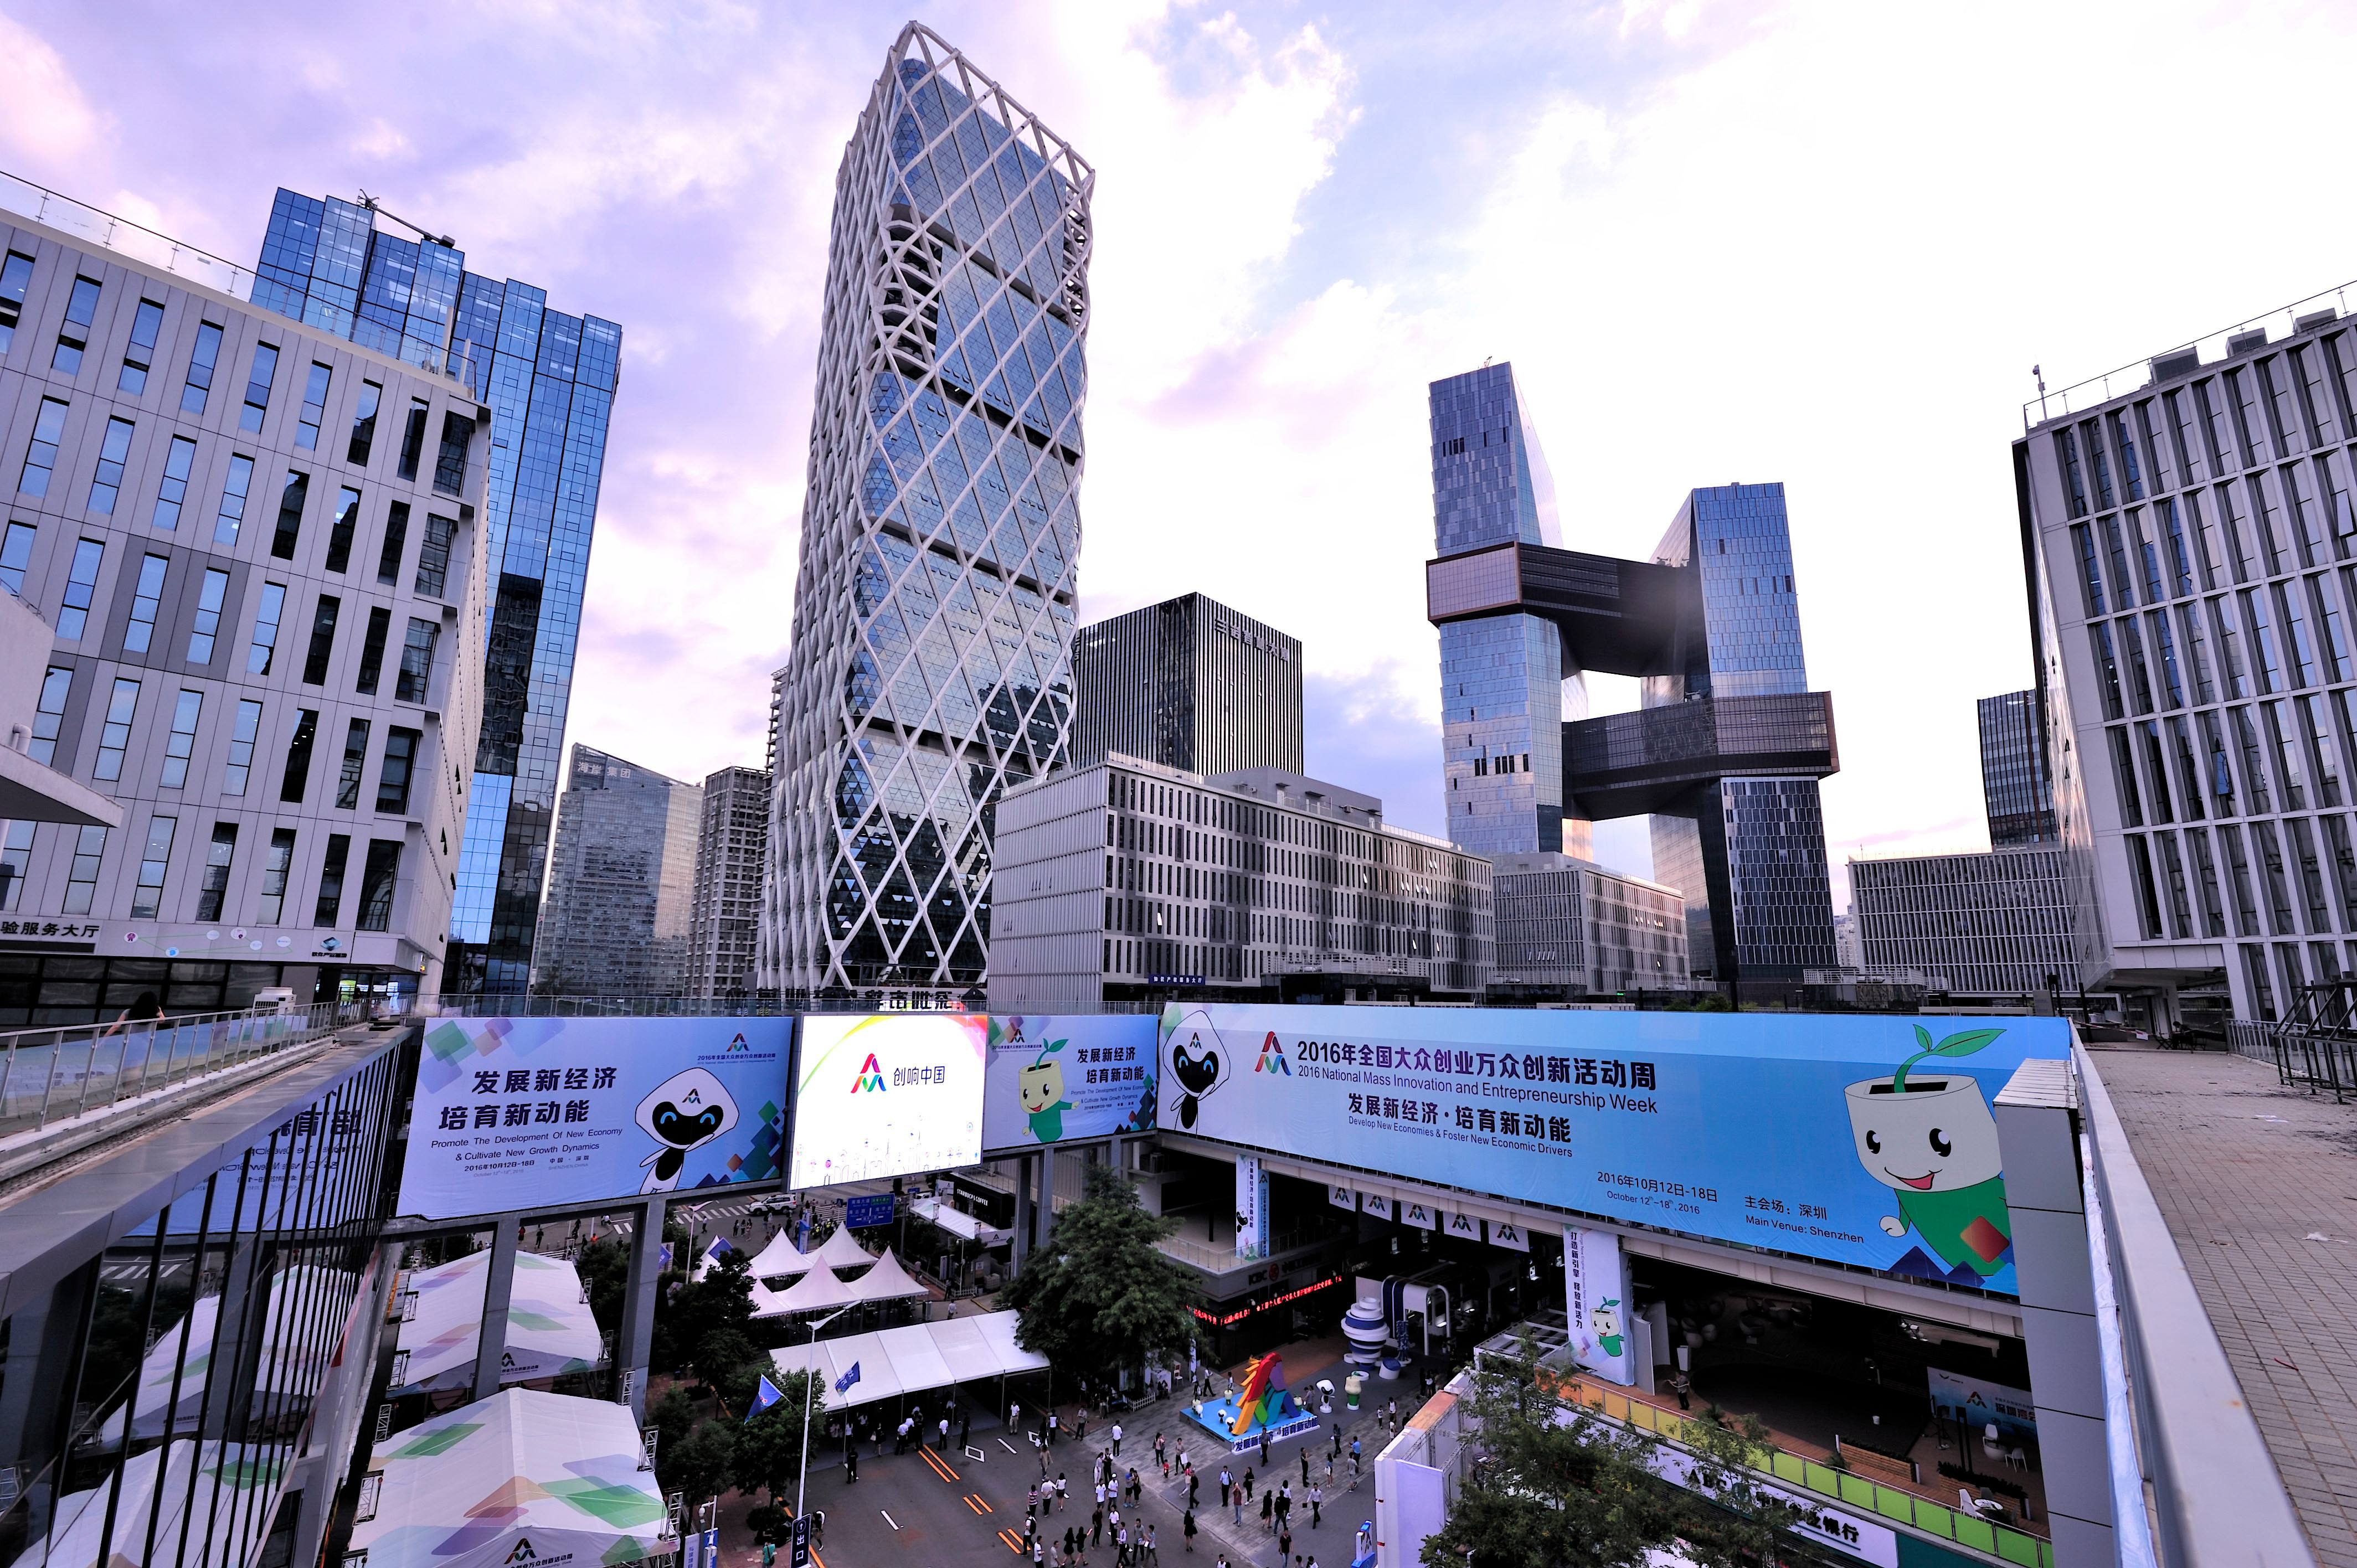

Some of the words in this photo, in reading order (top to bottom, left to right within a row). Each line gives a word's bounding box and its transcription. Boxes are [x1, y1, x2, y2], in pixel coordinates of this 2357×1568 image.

[1, 921, 100, 938] 验服务大厅
[1077, 1046, 1135, 1063] 发展新经济
[1298, 1041, 1656, 1091] 2016年全国大众创业万众创新活动周
[471, 1067, 617, 1095] 发展新经济
[893, 1066, 945, 1086] 创响中国
[1086, 1066, 1144, 1084] 培育新动能
[1298, 1065, 1320, 1079] 2016
[1322, 1068, 1361, 1082] National
[1363, 1072, 1391, 1086] Mass
[1394, 1074, 1452, 1092] Innovation
[1456, 1082, 1478, 1095] and
[1483, 1082, 1605, 1111] Entrepreneurship
[1609, 1093, 1658, 1113] Week
[439, 1100, 590, 1130] 培育新动能
[1349, 1093, 1571, 1143] 发展新经济·培育新动能
[431, 1139, 469, 1148] Promote
[474, 1137, 490, 1145] The
[495, 1133, 549, 1144] Development
[553, 1131, 563, 1139] Of
[567, 1130, 584, 1138] New
[588, 1127, 622, 1137] Economy
[1349, 1116, 1376, 1129] Develop
[1377, 1120, 1392, 1130] New
[1394, 1123, 1434, 1137] Economies
[1435, 1129, 1441, 1138] &
[1443, 1129, 1469, 1142] Foster
[1471, 1134, 1489, 1146] New
[1492, 1137, 1536, 1152] Economic
[1538, 1143, 1573, 1157] Drivers
[465, 1150, 501, 1160] Cultivate
[506, 1149, 525, 1157] New
[529, 1146, 558, 1156] Growth
[562, 1143, 600, 1153] Dynamics
[957, 1188, 975, 1201] STARBUCKS
[975, 1196, 988, 1206] COFFEE
[1597, 1171, 1717, 1203] 2016年10月12日-18日
[1607, 1190, 1637, 1204] October
[1679, 1204, 1700, 1215] 2016
[1746, 1215, 1769, 1227] Main
[1771, 1219, 1808, 1234] Venue:
[1810, 1226, 1865, 1244] Shenzhen
[1571, 1231, 1579, 1277] 打造新引擎
[1573, 1282, 1582, 1329] 释放新活力
[796, 1535, 805, 1561] 出口
